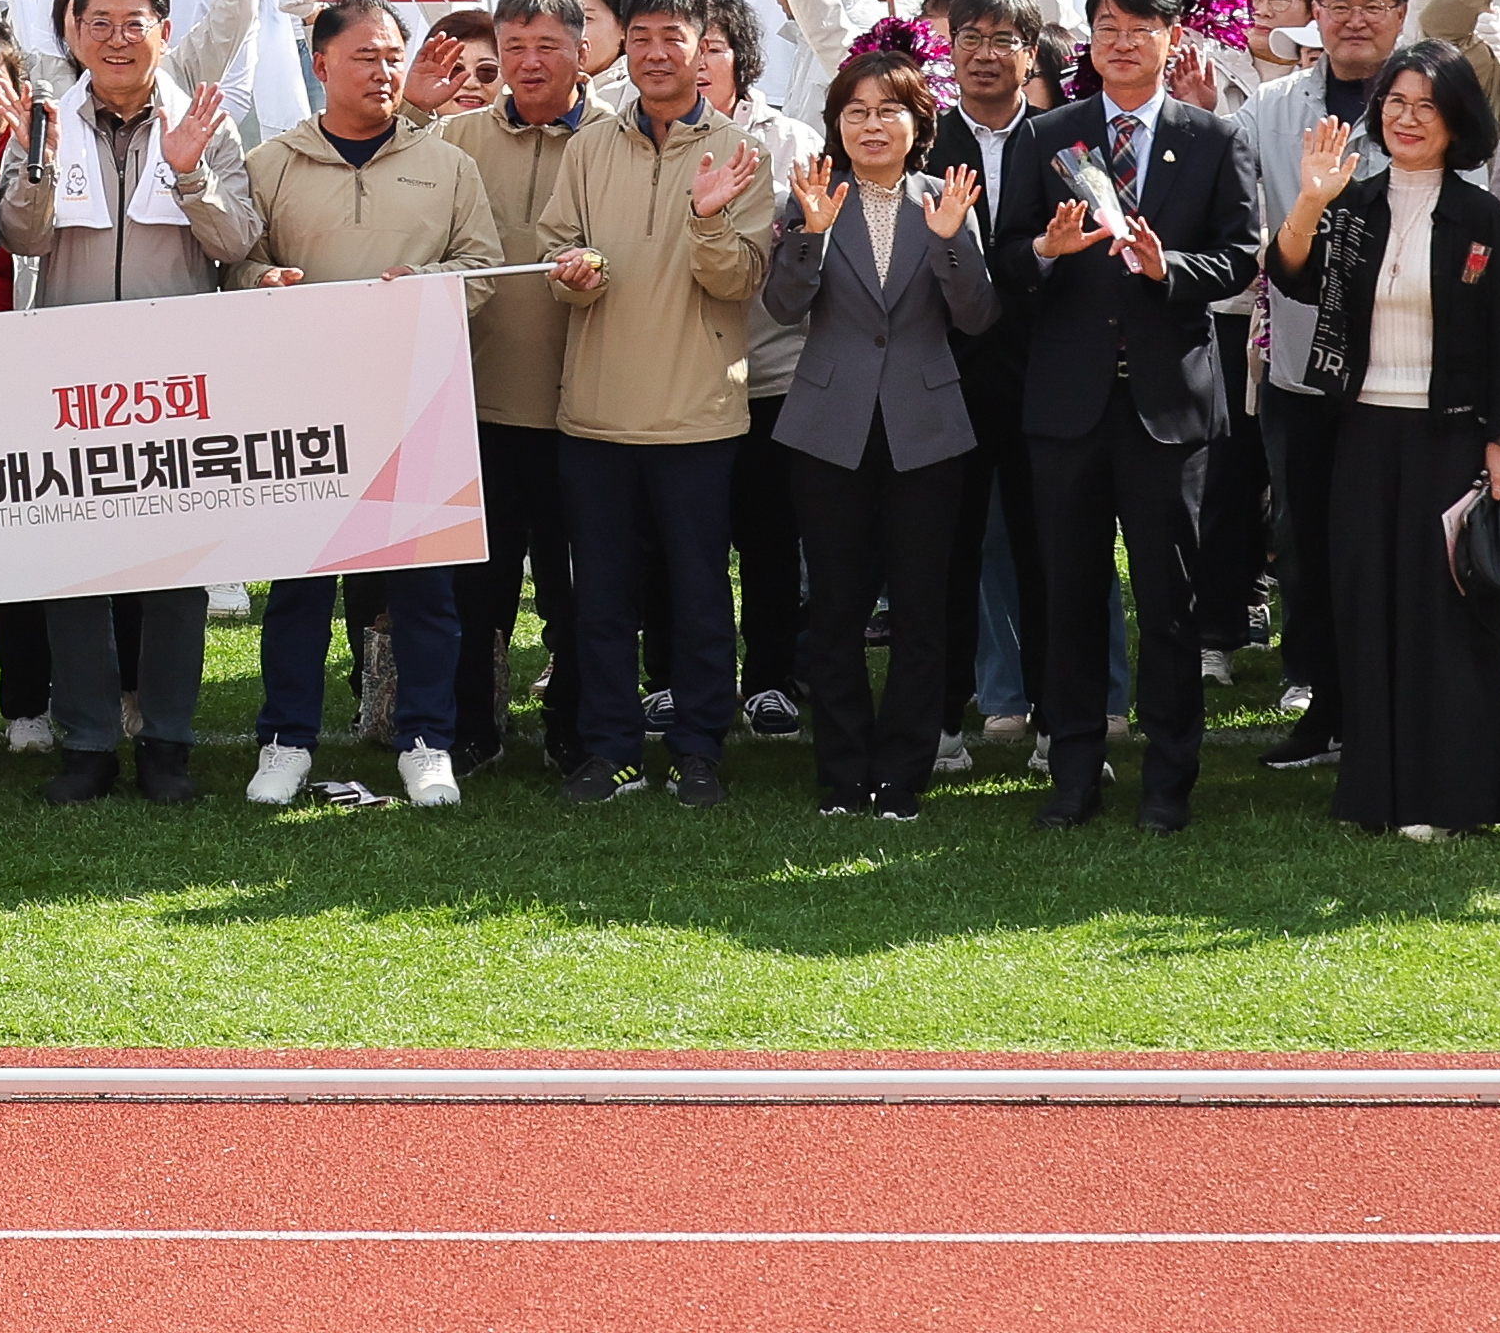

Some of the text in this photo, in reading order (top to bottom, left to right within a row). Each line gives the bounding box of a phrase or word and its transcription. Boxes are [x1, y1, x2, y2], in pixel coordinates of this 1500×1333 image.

[51, 373, 211, 431] 제25회
[27, 500, 98, 526] GIMHAE
[102, 493, 174, 520] CITIZEN
[178, 486, 255, 514] SPORTS
[260, 478, 350, 507] FESTIVAL
